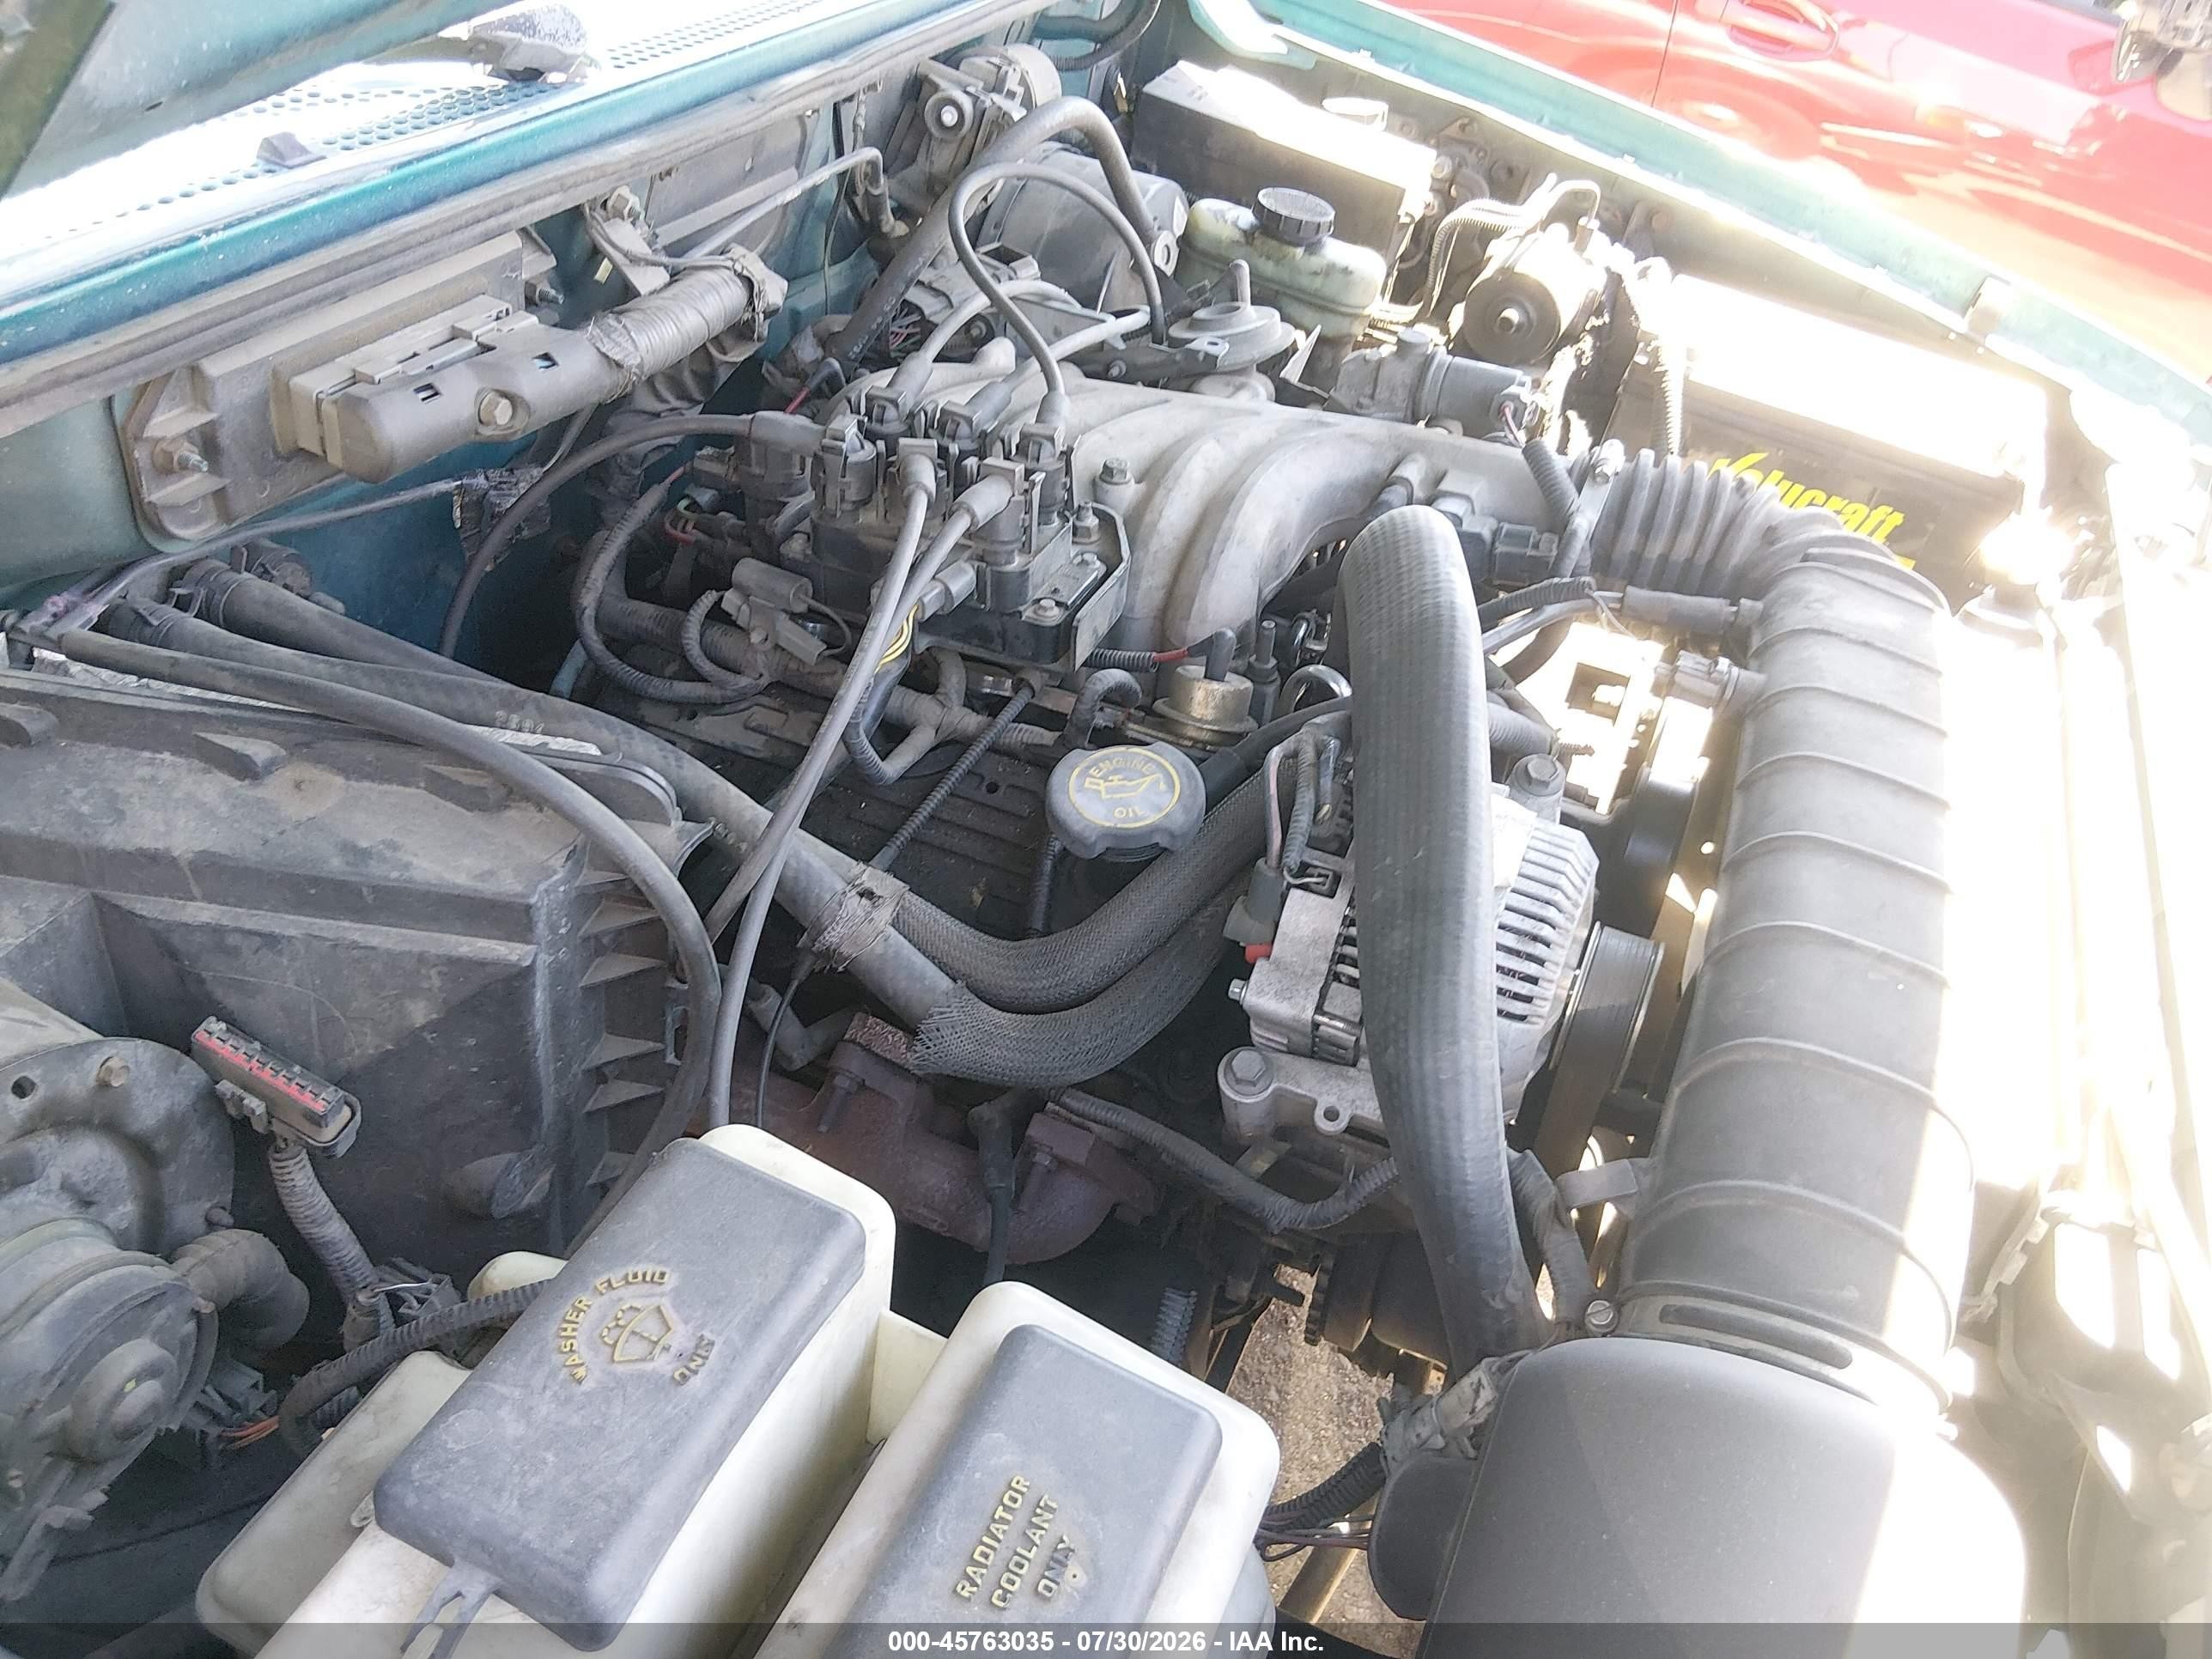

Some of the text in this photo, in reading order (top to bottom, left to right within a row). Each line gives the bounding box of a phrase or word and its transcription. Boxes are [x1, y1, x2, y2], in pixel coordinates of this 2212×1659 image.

[1089, 757, 1156, 777] ENGINE
[1113, 806, 1147, 818] OIL
[559, 1269, 669, 1384] WASHER FLUID
[955, 1475, 1030, 1600] RADIATOR
[991, 1494, 1059, 1608] COOLANT
[1037, 1534, 1075, 1598] ONLY
